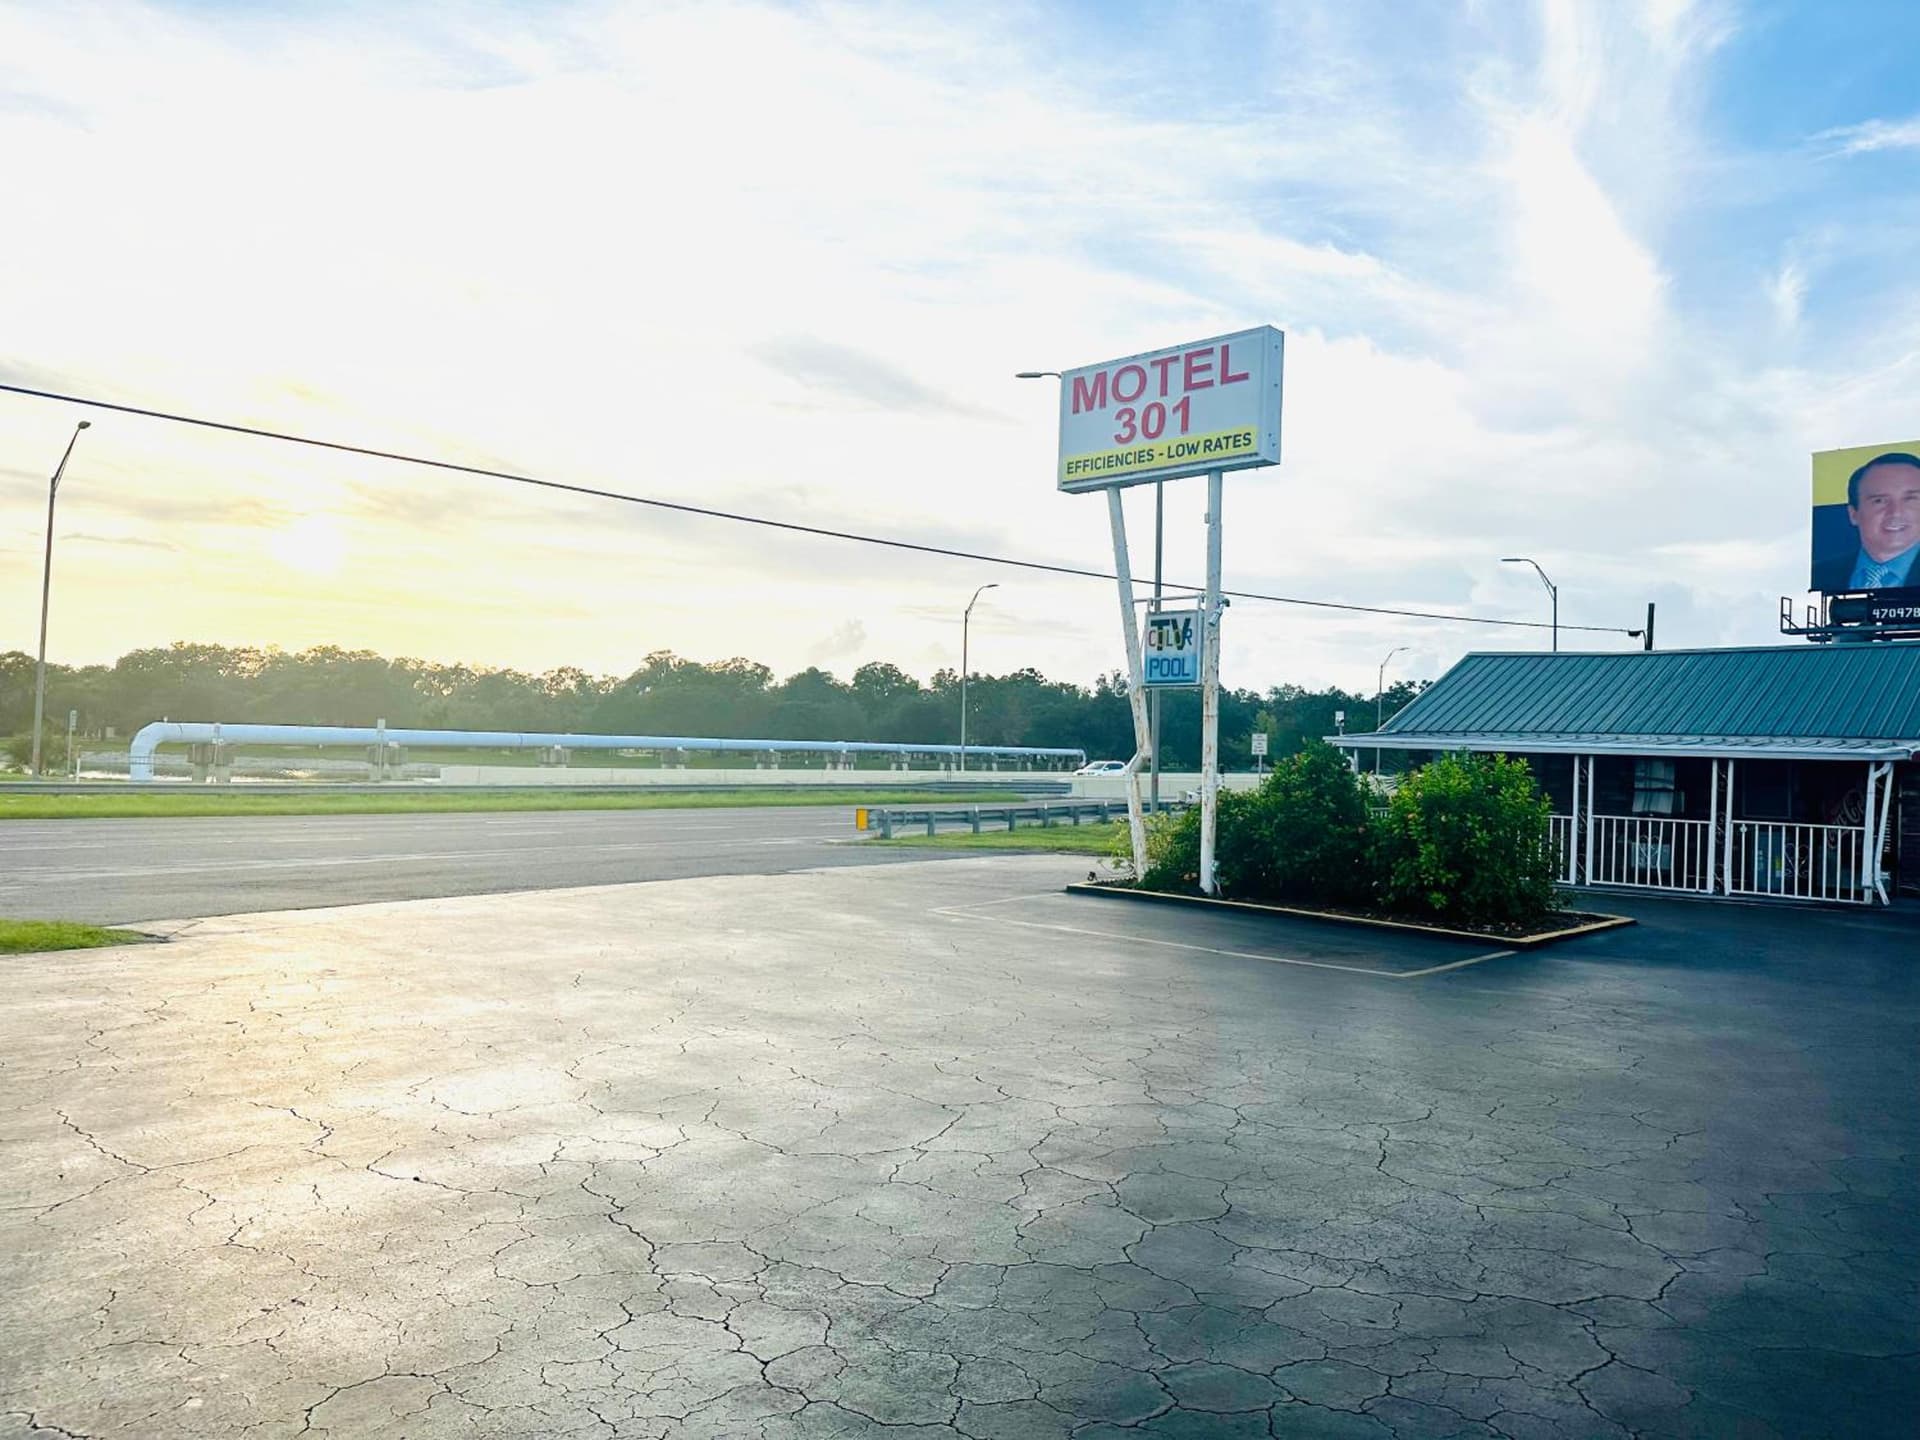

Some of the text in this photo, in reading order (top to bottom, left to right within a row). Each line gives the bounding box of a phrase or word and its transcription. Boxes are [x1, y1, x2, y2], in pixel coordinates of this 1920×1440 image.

[1072, 344, 1249, 414] MOTEL
[1114, 396, 1191, 445] 301
[1066, 449, 1155, 474] EFFICIENCIES
[1168, 441, 1200, 459] LOW
[1203, 431, 1252, 453] RATES
[1151, 618, 1191, 651] TV
[1150, 658, 1190, 678] POOL
